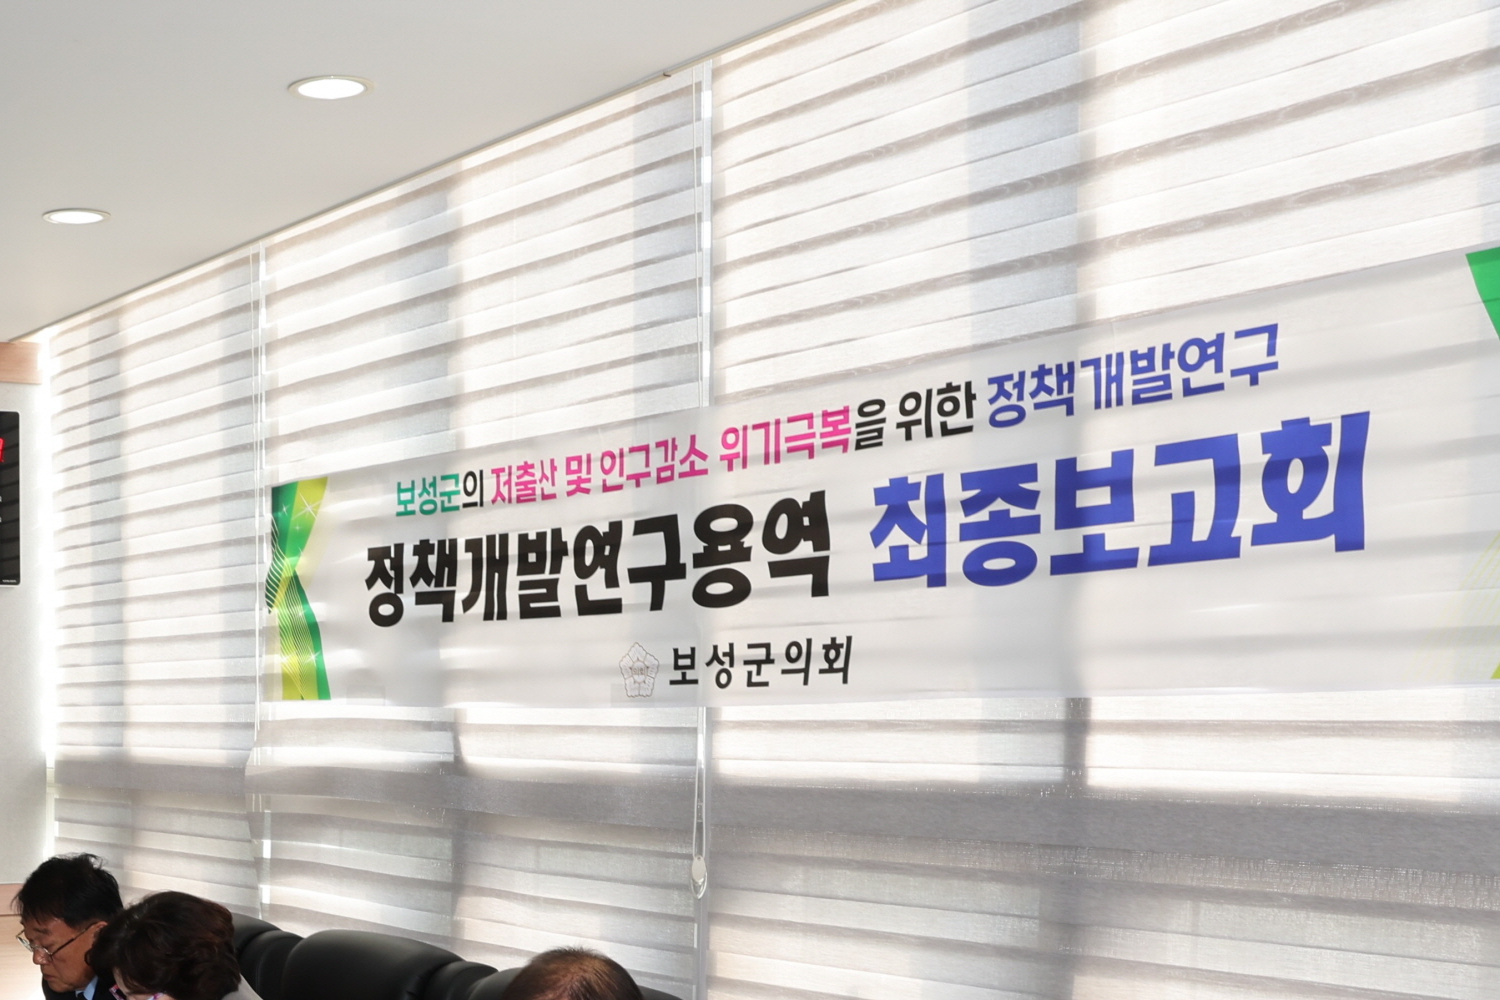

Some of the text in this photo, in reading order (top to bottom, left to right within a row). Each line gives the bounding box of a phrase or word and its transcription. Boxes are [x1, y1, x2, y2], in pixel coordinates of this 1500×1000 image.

[395, 322, 1280, 518] 보성군의 저출산 및 인구감소 위기극복을 위한 정책개발연구
[364, 410, 1371, 628] 정책개발연구용역 최종보고회
[668, 635, 854, 691] 보성군의회
